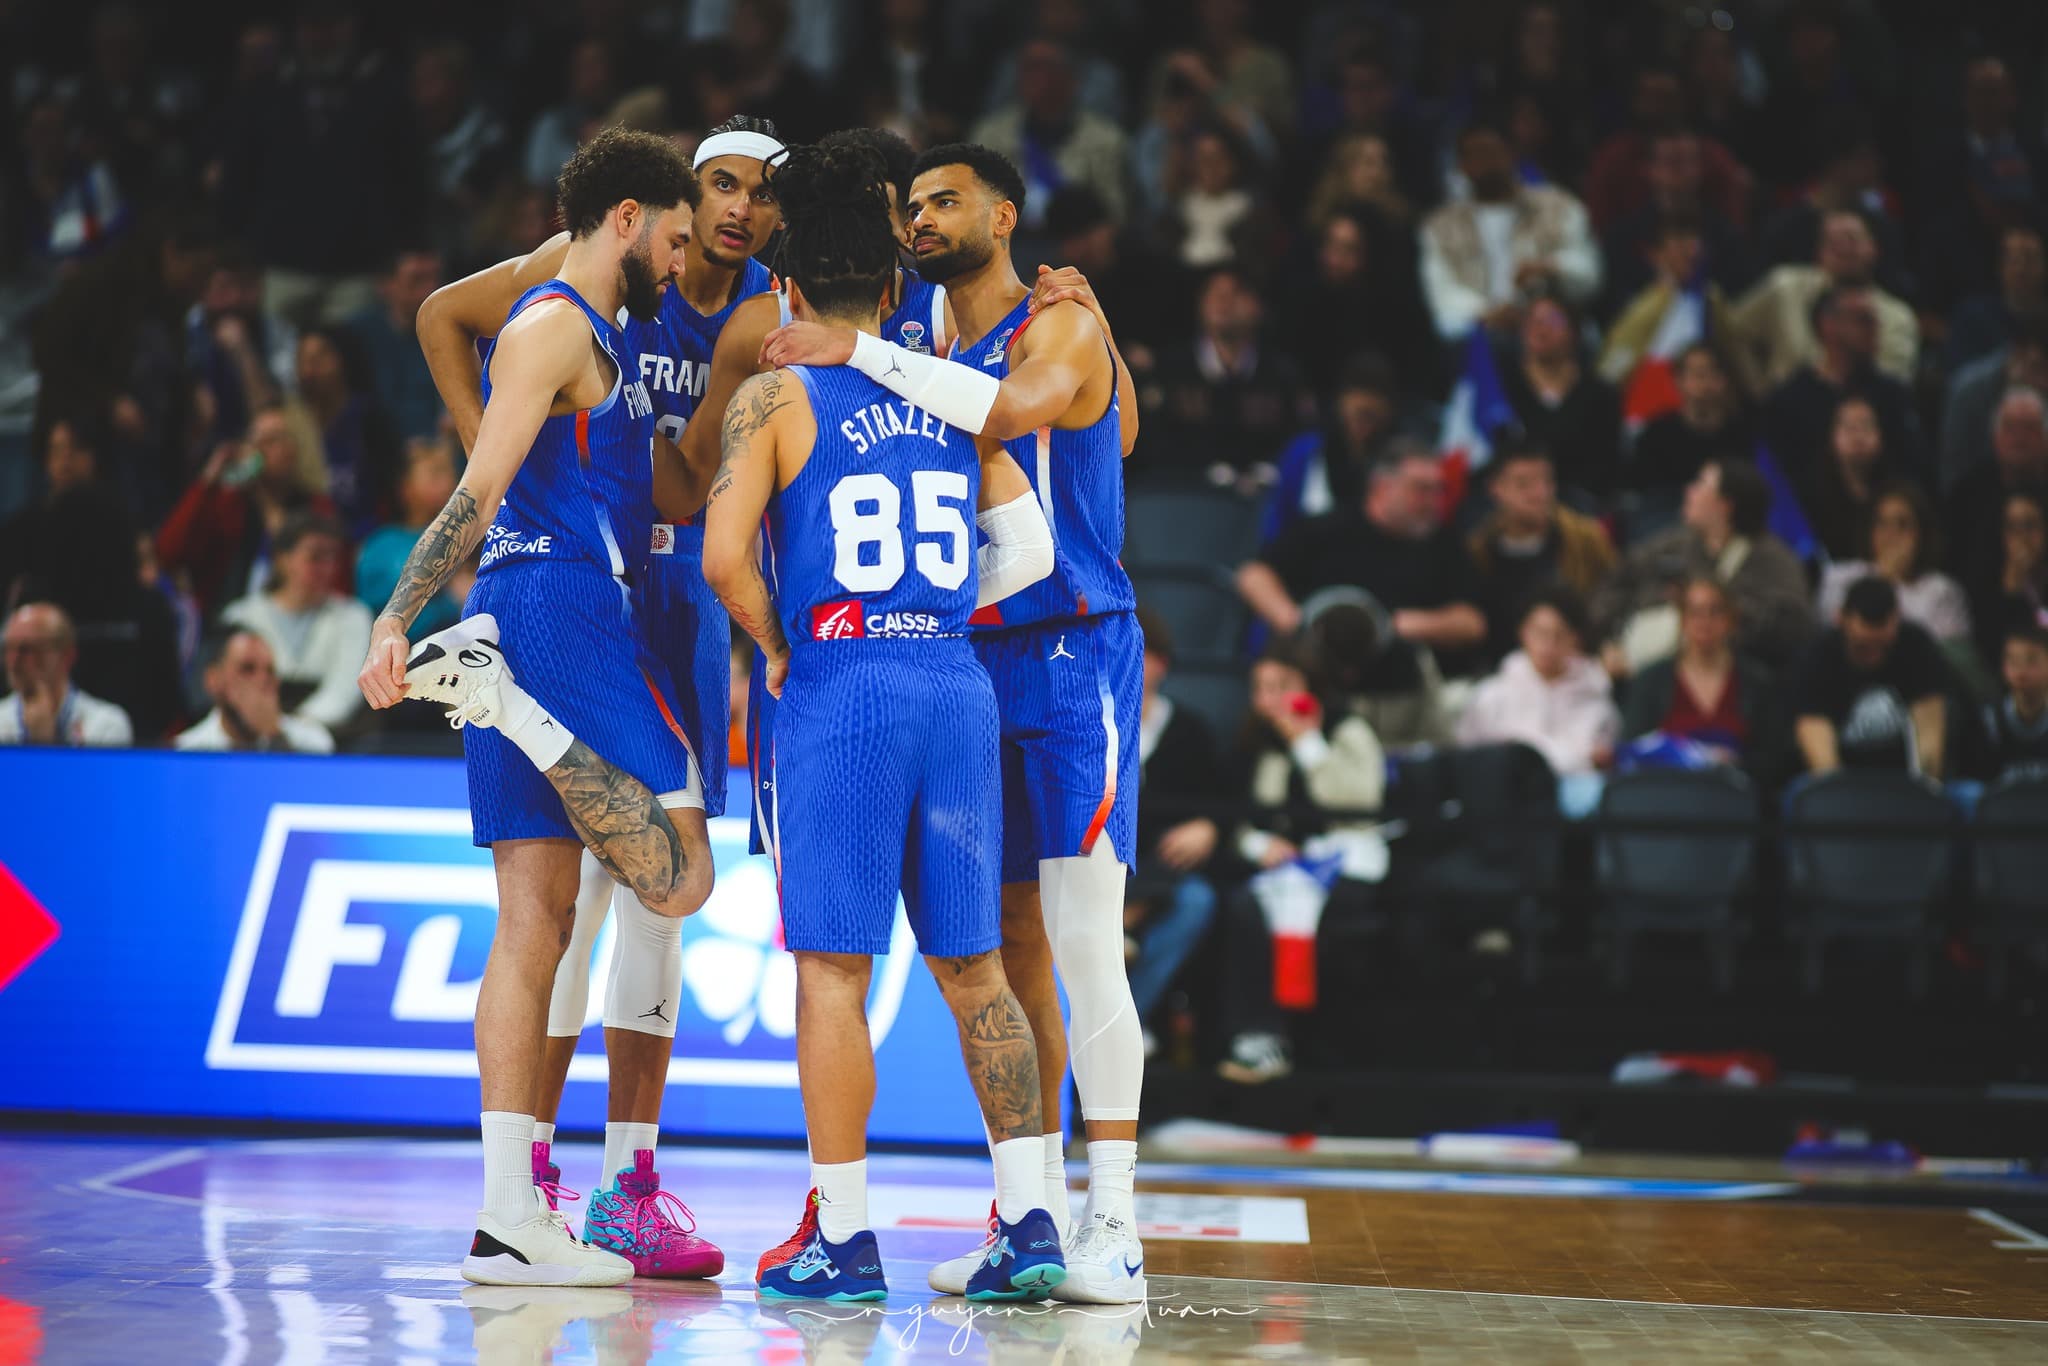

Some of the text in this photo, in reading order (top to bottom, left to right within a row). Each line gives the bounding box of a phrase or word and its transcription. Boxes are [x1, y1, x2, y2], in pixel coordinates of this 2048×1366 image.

[638, 353, 711, 397] FRAN
[840, 400, 948, 455] STRAZEL
[828, 470, 970, 593] 85
[866, 612, 940, 633] CAISSE
